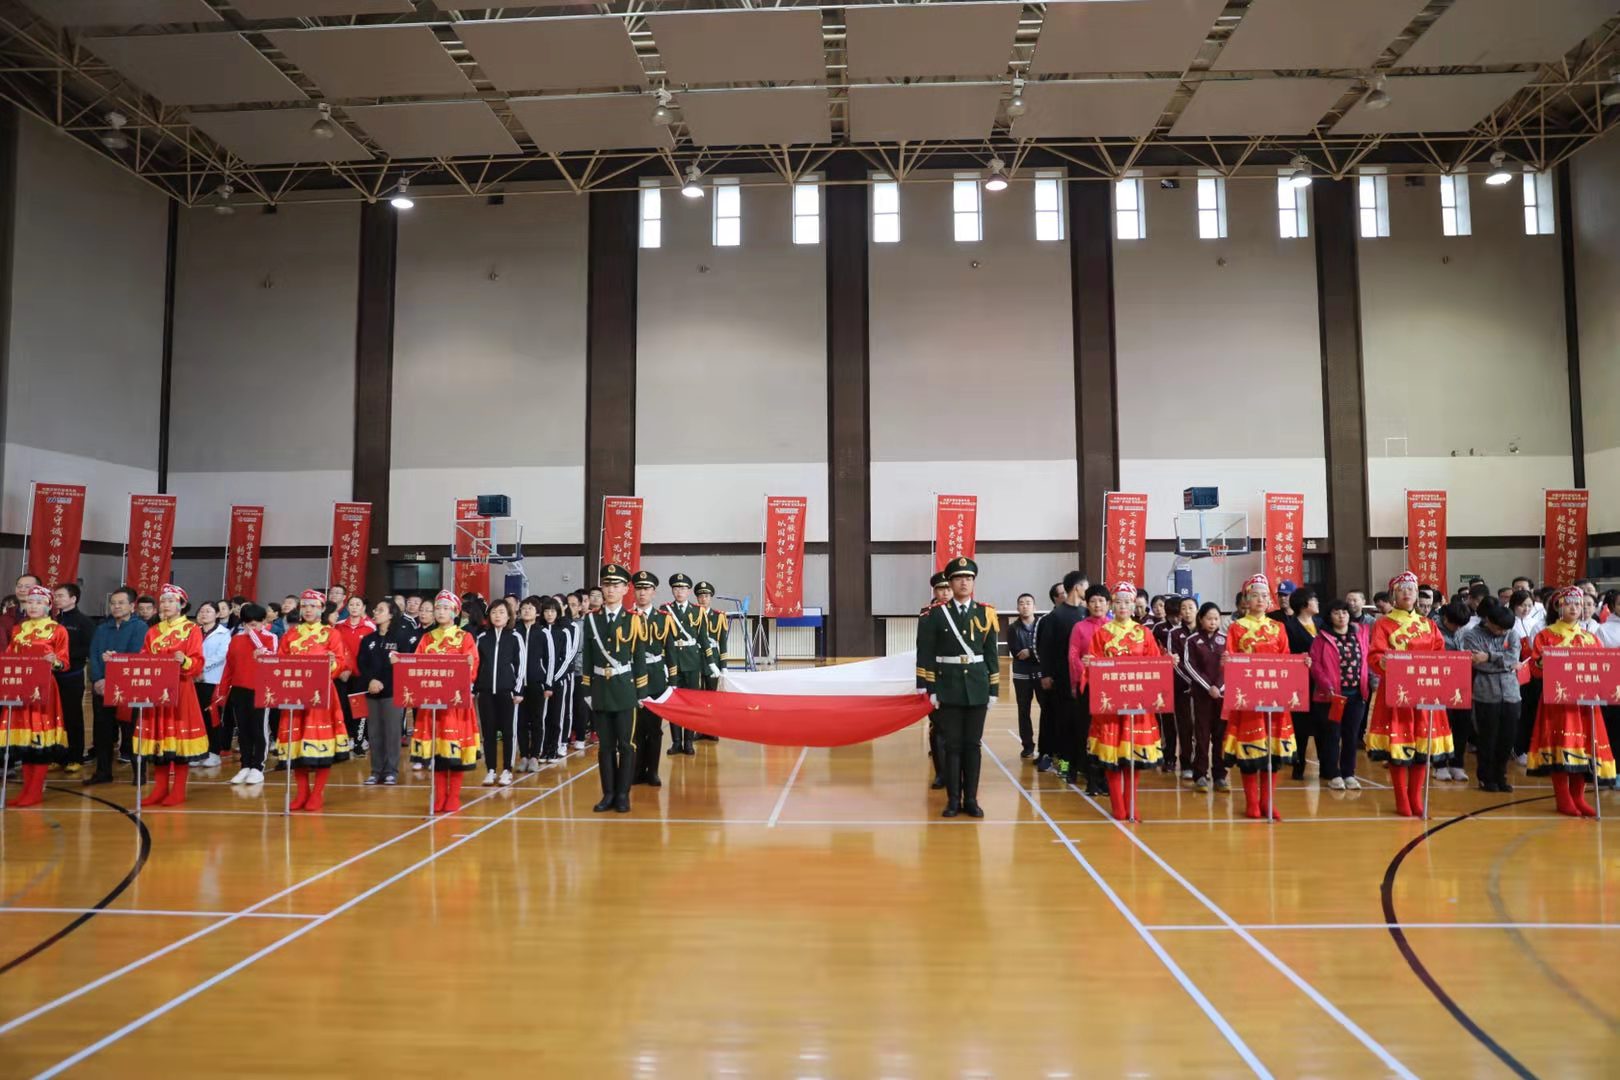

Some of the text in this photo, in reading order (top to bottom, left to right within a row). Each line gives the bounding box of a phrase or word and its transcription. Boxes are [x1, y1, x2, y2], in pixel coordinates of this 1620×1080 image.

[350, 521, 361, 558] 中信银行
[123, 668, 161, 676] 交通银行
[273, 669, 312, 677] 中国银行
[408, 669, 455, 677] 国家开发银行
[1244, 669, 1288, 678] 工商银行
[1407, 666, 1451, 675] 建设银行
[1102, 672, 1160, 680] 内蒙古银保监局
[131, 679, 152, 687] 代表队
[282, 680, 303, 688] 代表队
[421, 680, 442, 688] 代表队
[1255, 681, 1278, 689] 代表队
[1417, 678, 1441, 686] 代表队
[1120, 684, 1143, 692] 代表队
